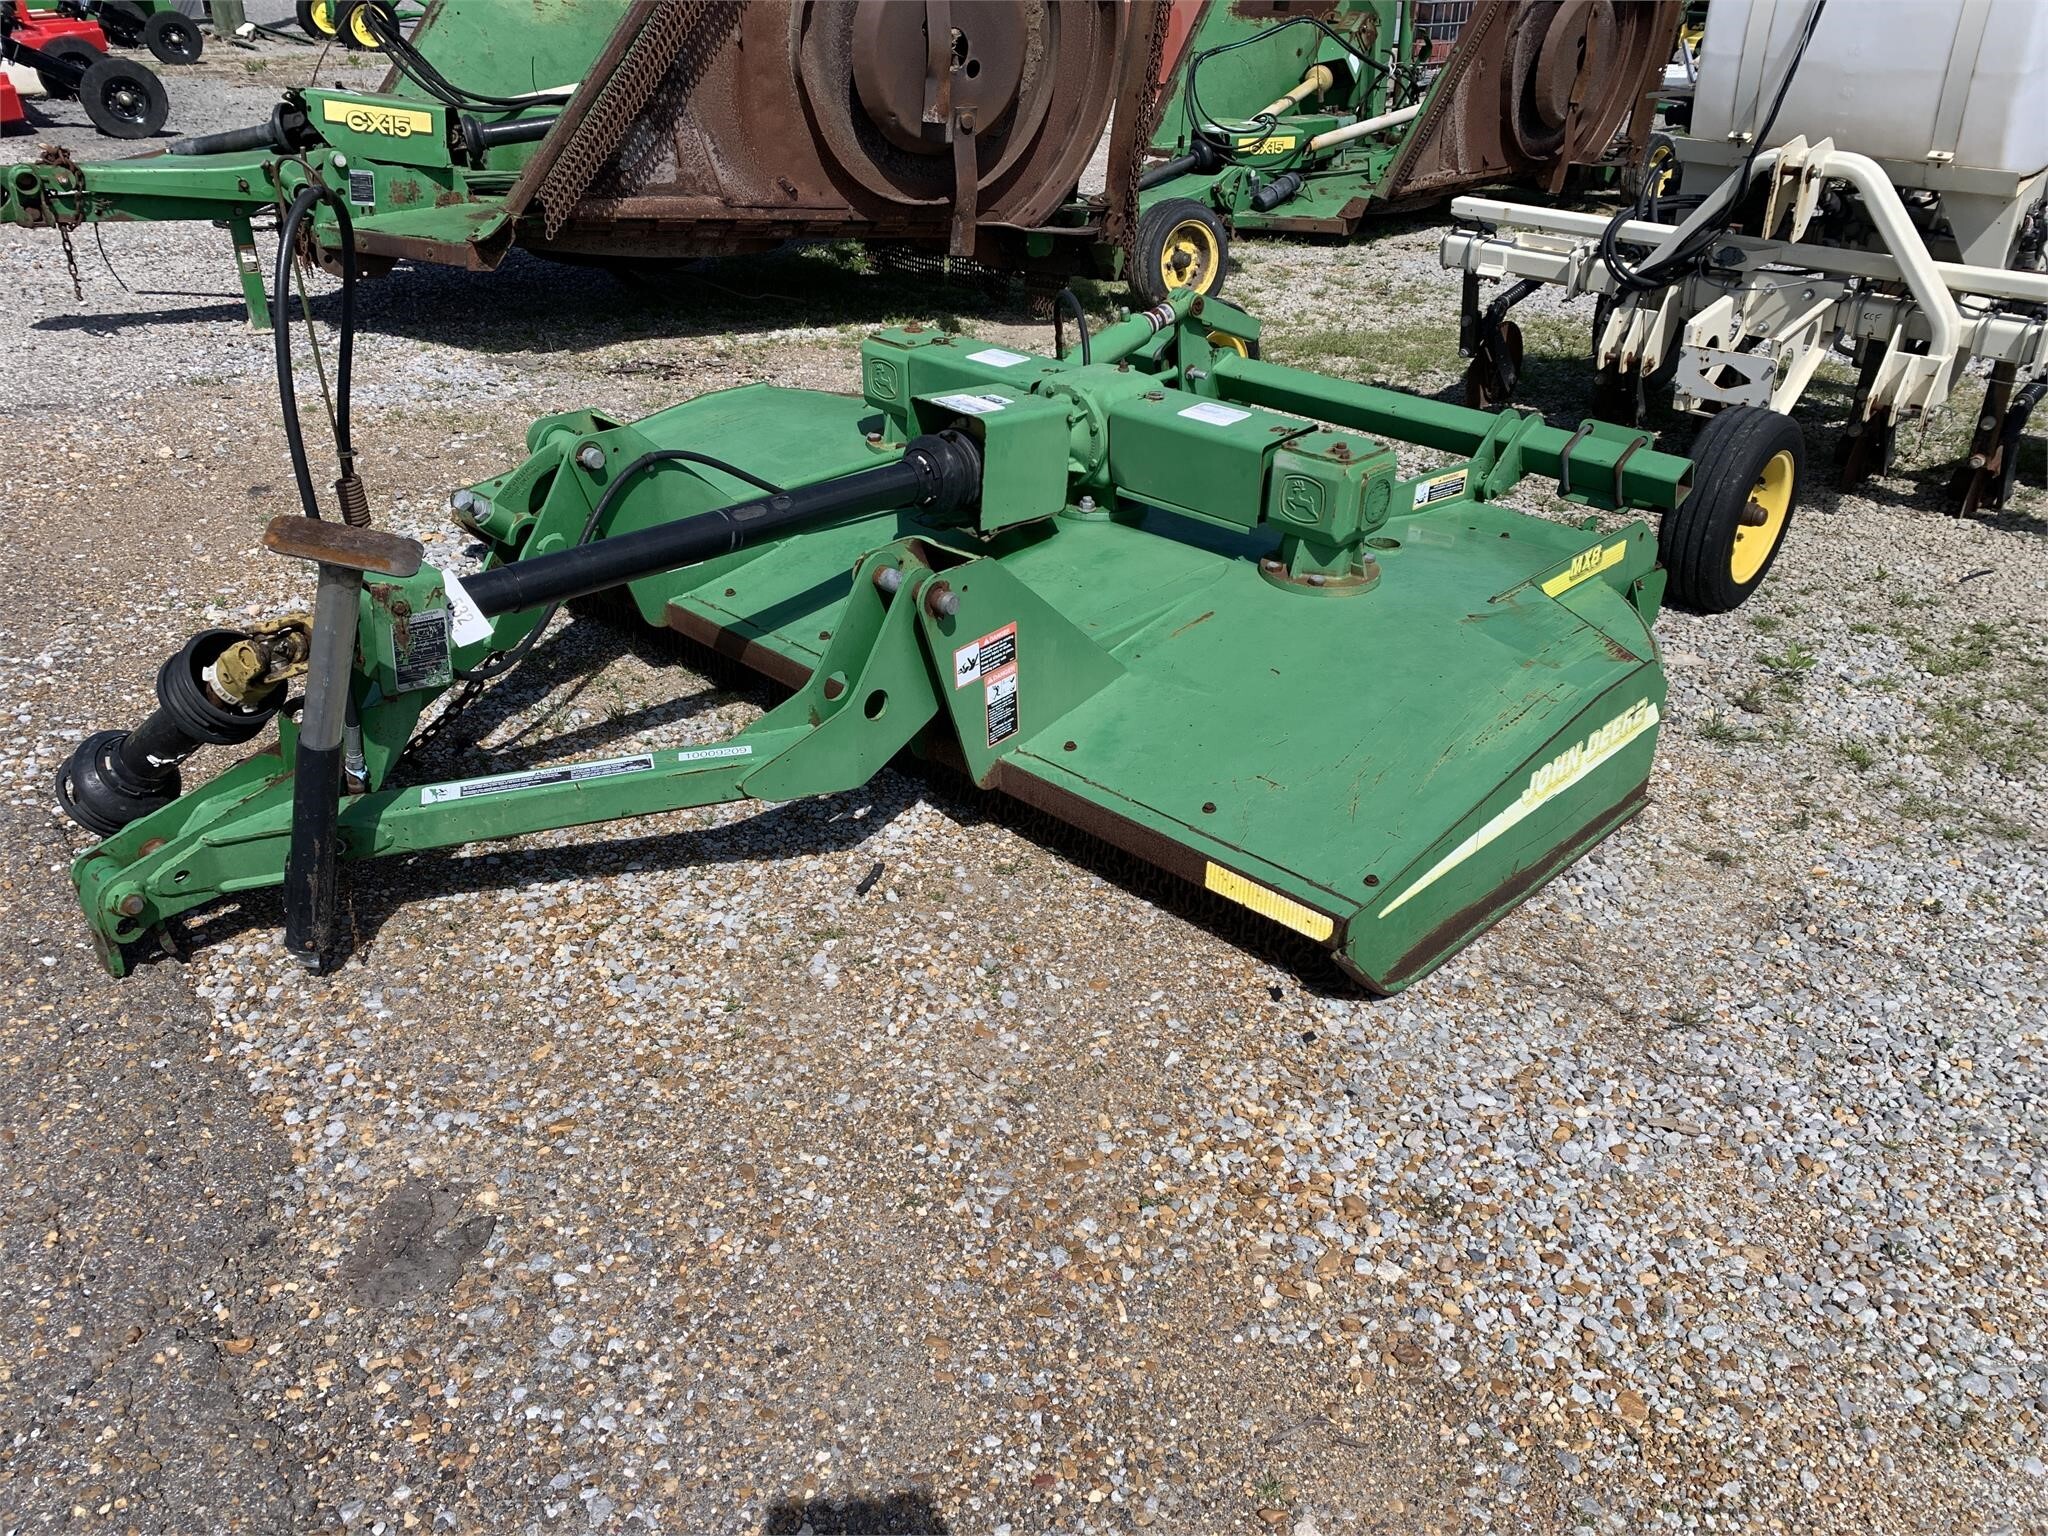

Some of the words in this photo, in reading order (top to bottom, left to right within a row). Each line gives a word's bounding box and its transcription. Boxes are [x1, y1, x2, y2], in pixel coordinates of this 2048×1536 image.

[346, 110, 411, 138] CX15
[1569, 544, 1602, 580] MX8
[686, 748, 748, 760] 10009209
[1522, 740, 1584, 808] JOHN
[1585, 697, 1649, 762] DEERE
